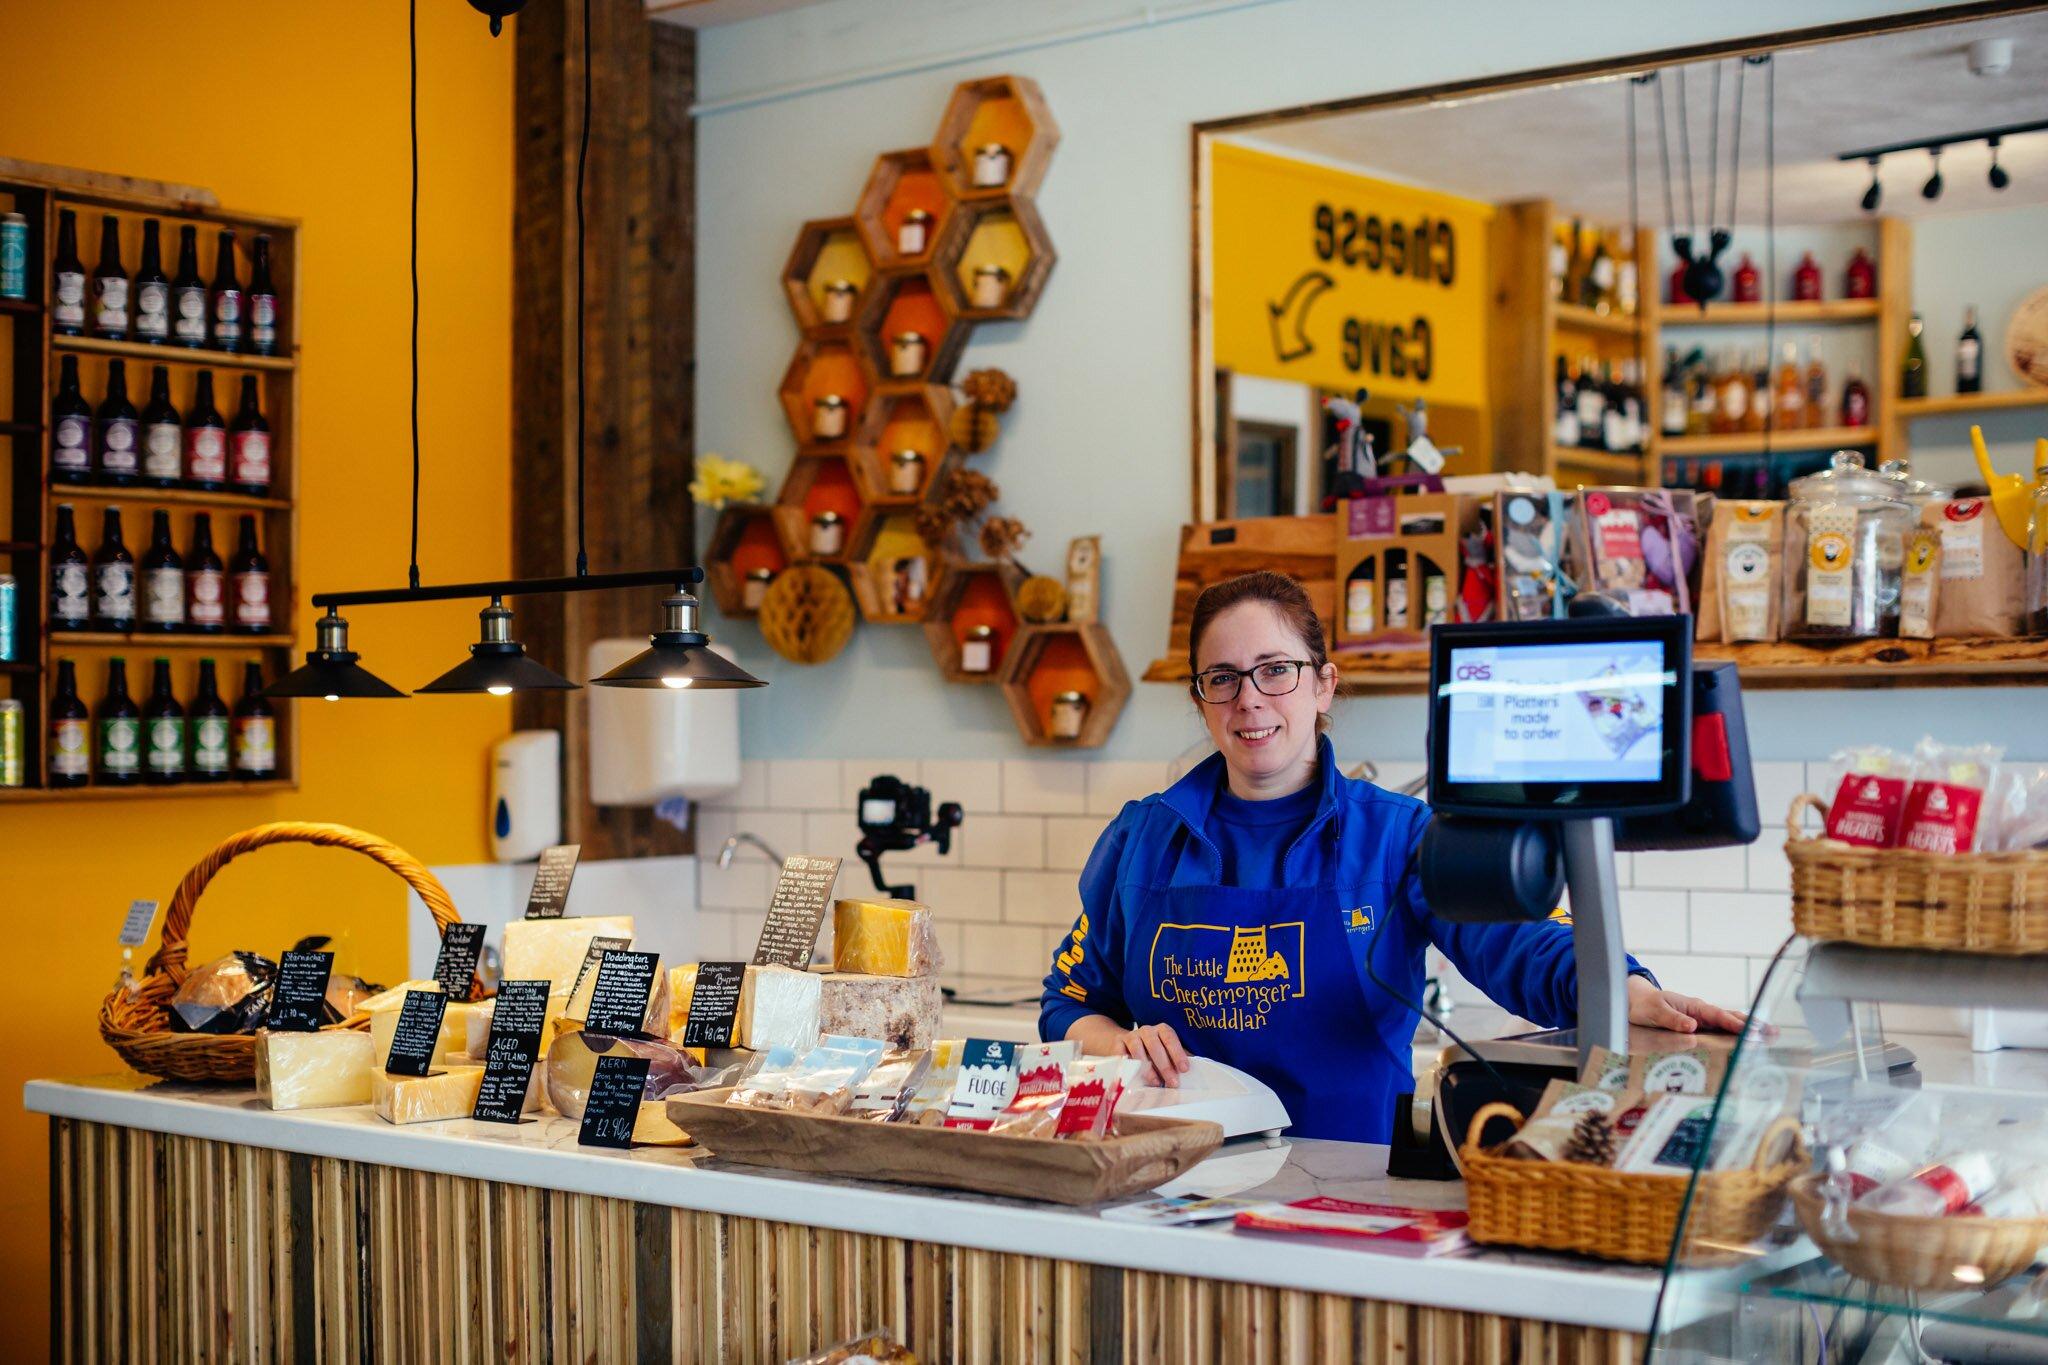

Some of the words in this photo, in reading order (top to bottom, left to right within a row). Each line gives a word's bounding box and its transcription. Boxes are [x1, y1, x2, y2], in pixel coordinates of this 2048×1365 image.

[1504, 694, 1559, 709] Platters
[1511, 711, 1550, 724] made
[1504, 728, 1519, 740] to
[1522, 726, 1561, 740] order
[604, 951, 650, 966] Doddington
[1164, 954, 1183, 976] The
[1187, 957, 1223, 978] Little
[1161, 977, 1291, 1014] Cheesemonger
[1184, 1007, 1267, 1032] Rhuddlan
[493, 1038, 519, 1050] AGED
[490, 1050, 528, 1061] RUTLAND
[488, 1062, 504, 1070] RED
[600, 1058, 628, 1069] KERN
[968, 1078, 1007, 1096] FUDGE
